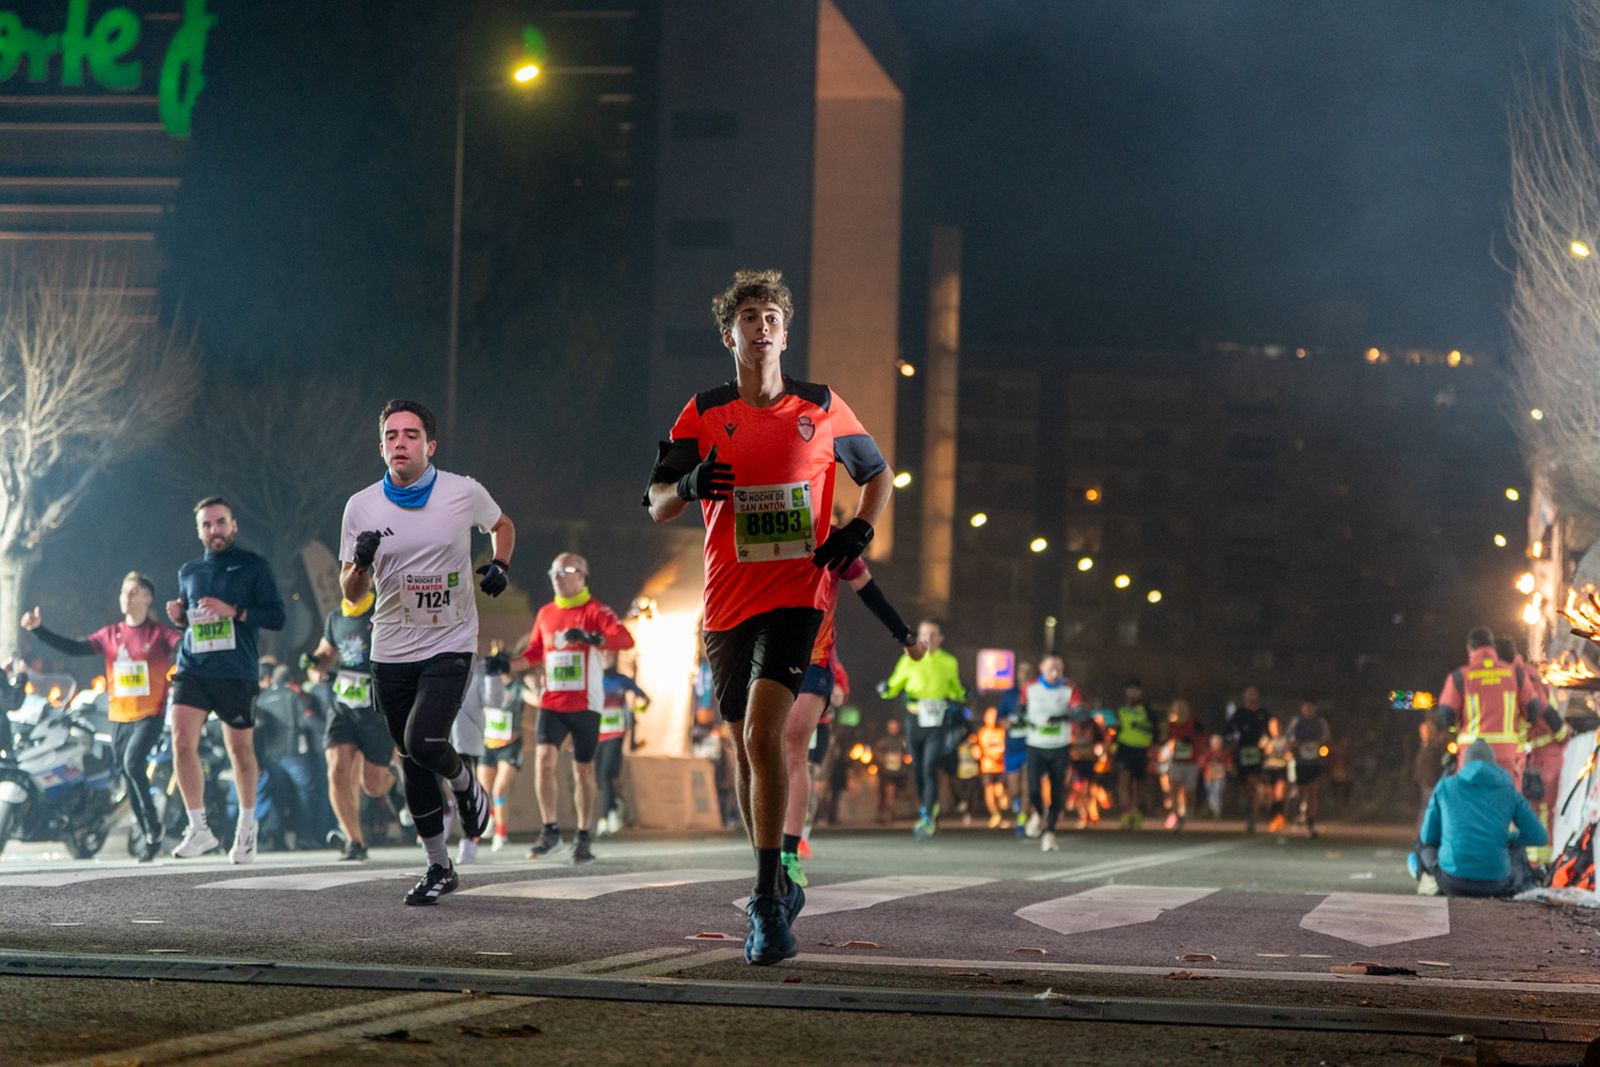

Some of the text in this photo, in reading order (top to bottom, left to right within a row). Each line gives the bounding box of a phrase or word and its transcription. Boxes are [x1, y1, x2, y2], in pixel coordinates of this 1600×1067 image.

[749, 493, 773, 502] NOCHE
[775, 492, 785, 501] DE
[740, 503, 756, 512] SAN
[757, 501, 786, 511] ANTÓN
[747, 510, 801, 536] 8893
[415, 590, 451, 608] 7124
[198, 621, 224, 637] 3012
